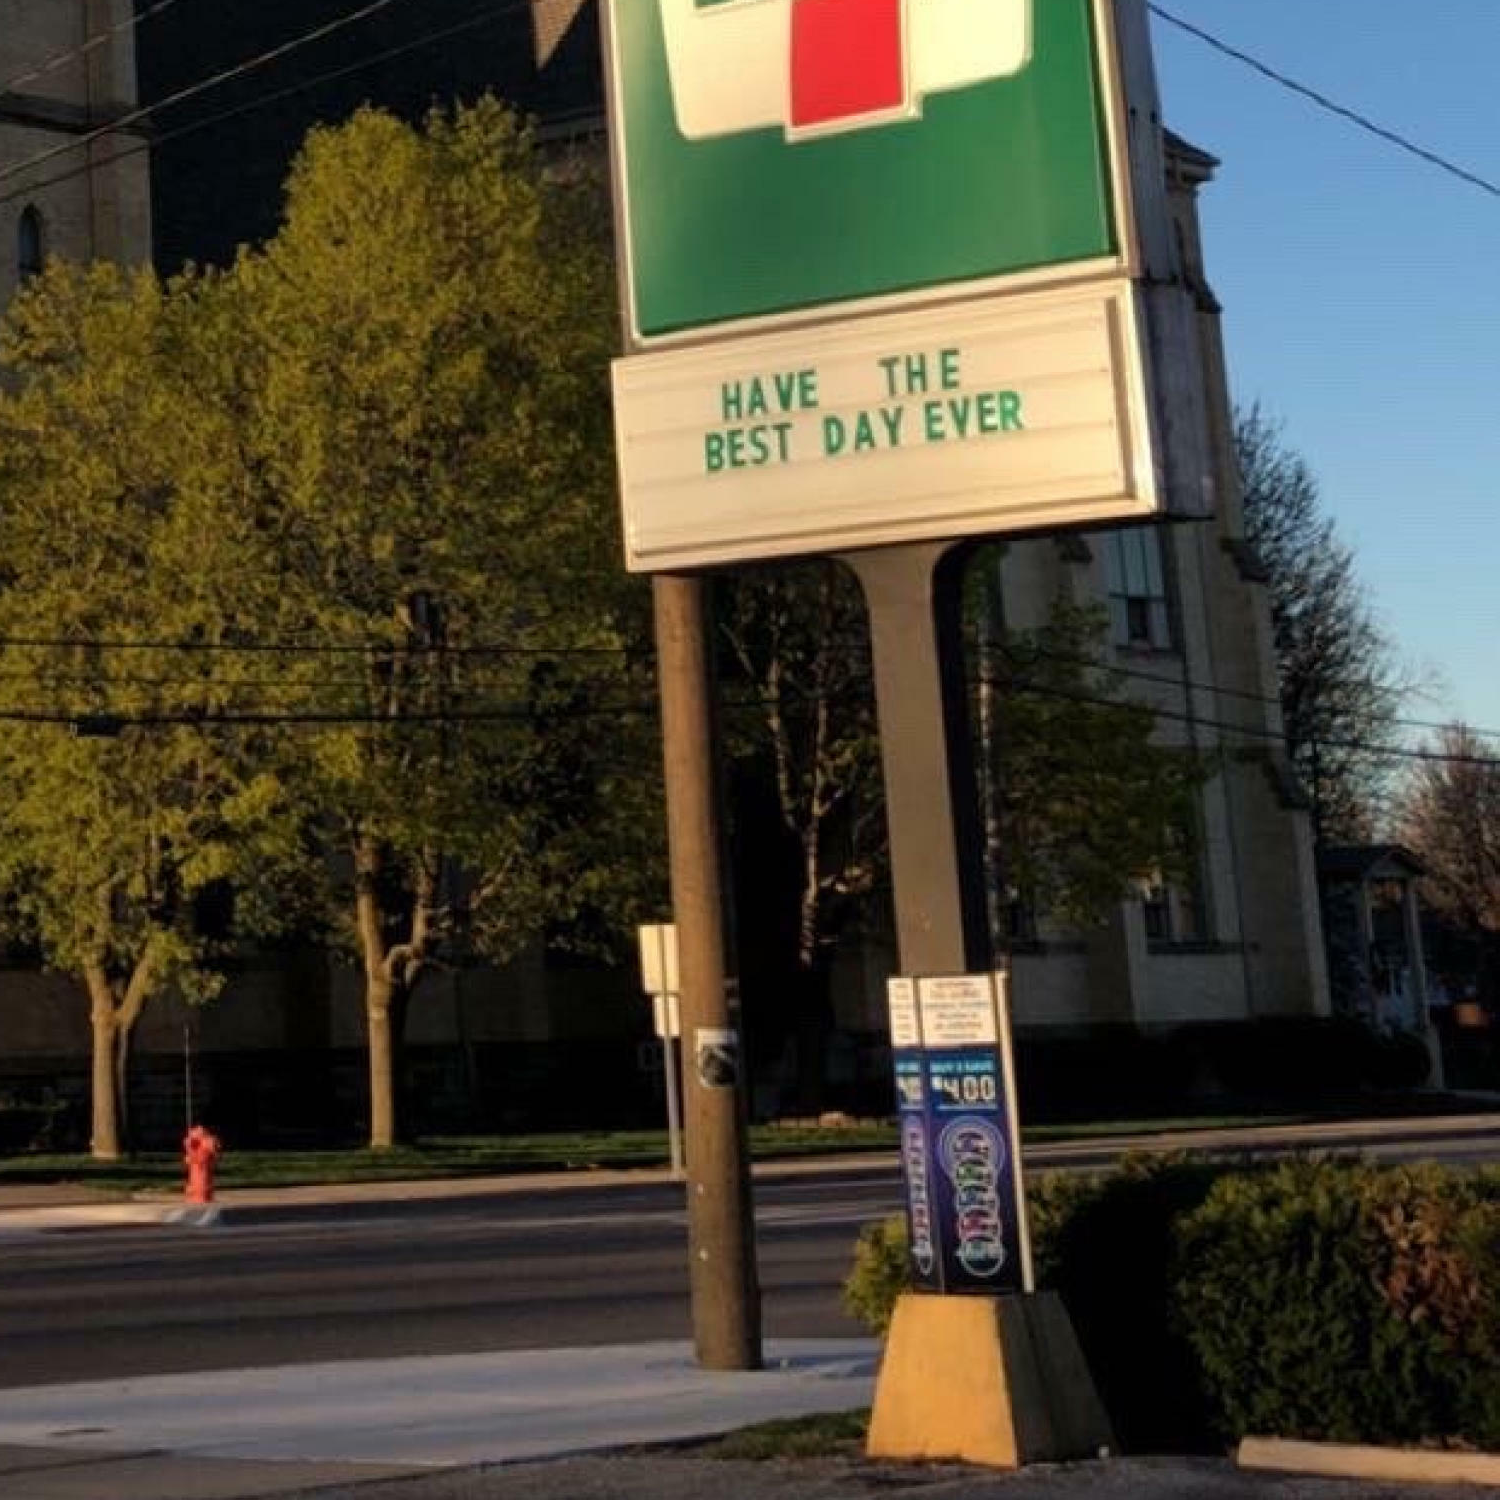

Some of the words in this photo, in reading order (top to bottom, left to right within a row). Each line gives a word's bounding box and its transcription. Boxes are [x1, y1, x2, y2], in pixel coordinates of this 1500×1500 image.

[721, 369, 819, 421] HAVE
[878, 349, 960, 397] THE
[705, 423, 794, 472] BEST
[823, 406, 904, 455] DAY
[924, 391, 1024, 442] EVER
